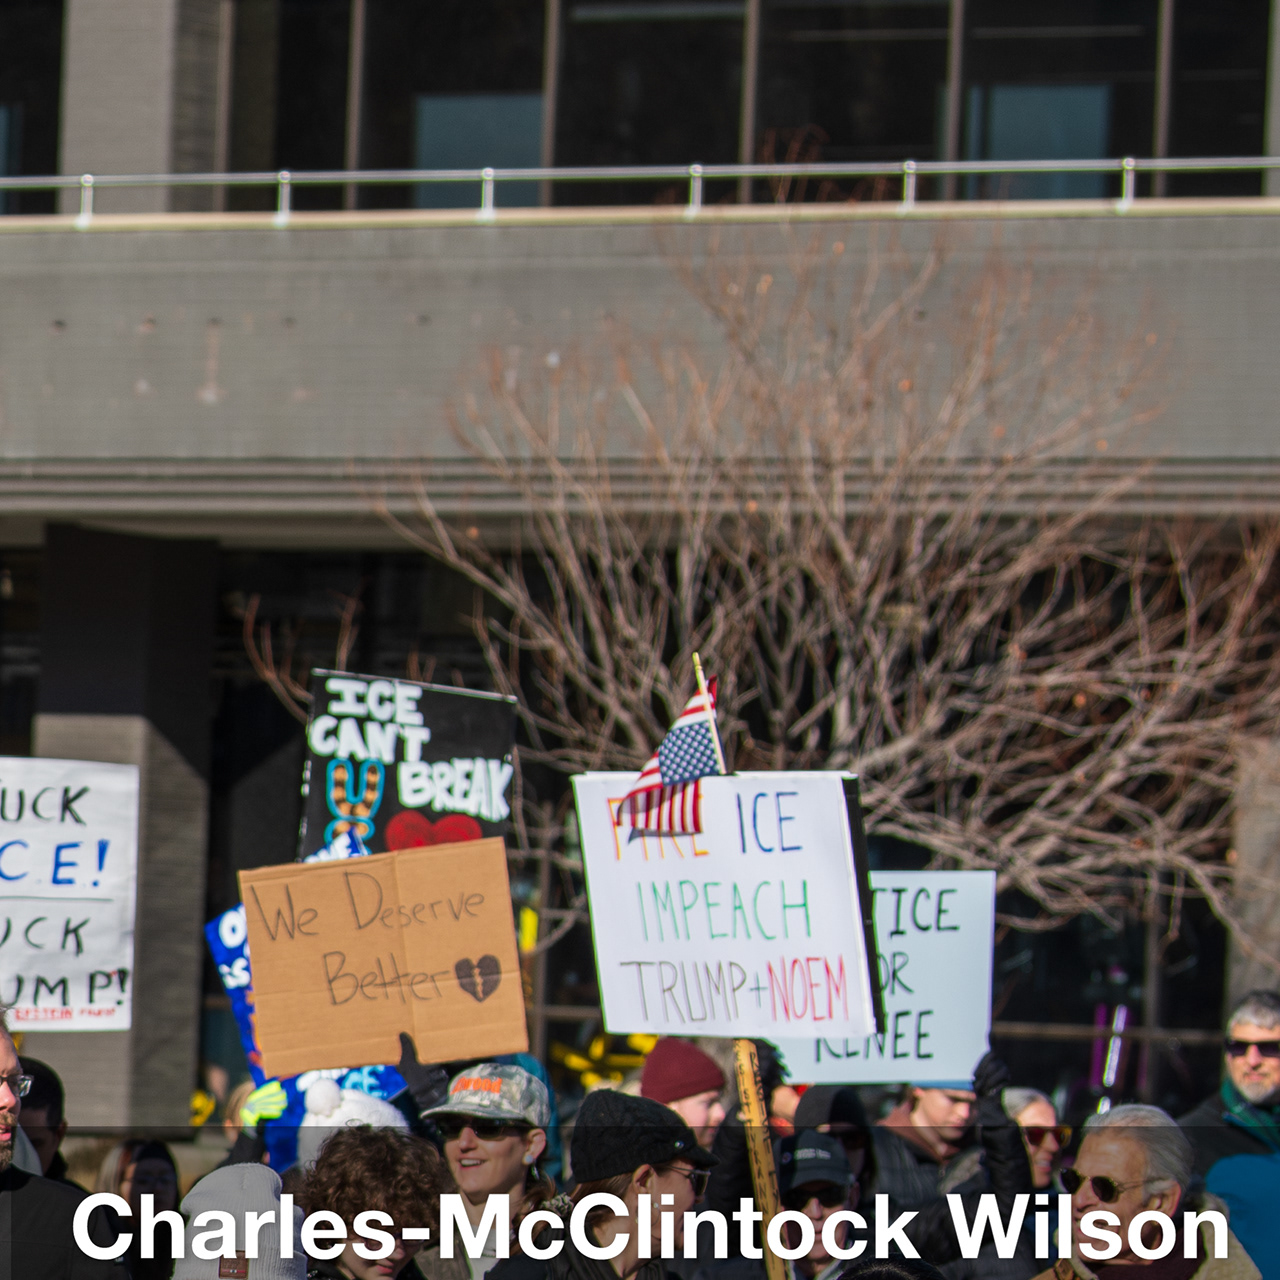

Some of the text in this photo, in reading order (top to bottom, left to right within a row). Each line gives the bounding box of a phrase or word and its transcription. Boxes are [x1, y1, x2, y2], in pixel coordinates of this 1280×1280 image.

[325, 678, 425, 727] ICE
[308, 714, 431, 766] CAN'T
[397, 757, 514, 822] BREAK
[736, 791, 803, 854] ICE
[250, 883, 319, 942] We
[344, 870, 485, 932] Deserve
[637, 879, 812, 942] IMPEACH
[322, 951, 452, 1006] Better
